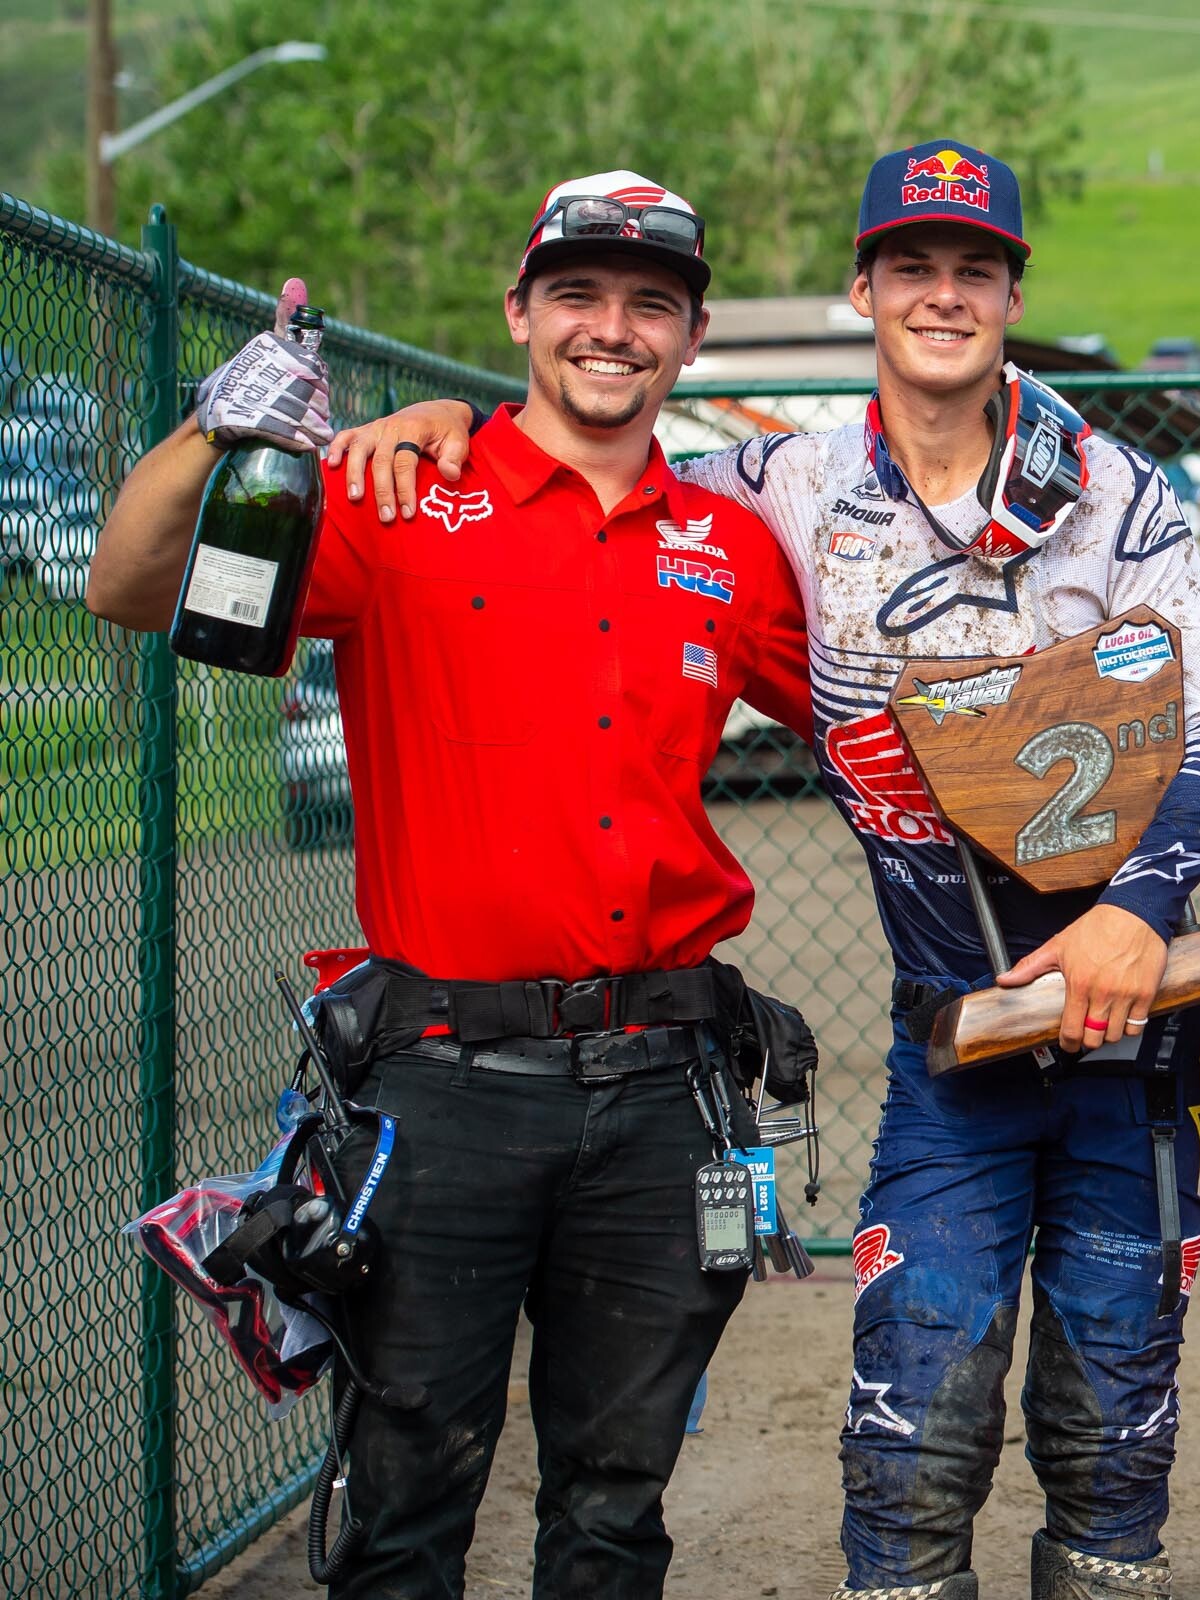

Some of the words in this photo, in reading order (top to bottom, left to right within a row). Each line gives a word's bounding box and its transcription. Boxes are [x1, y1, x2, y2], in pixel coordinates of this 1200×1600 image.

[902, 181, 947, 206] Red
[948, 182, 990, 212] Bull
[1030, 430, 1057, 480] 100%
[831, 498, 897, 527] SHOWA
[657, 540, 729, 560] HONDA
[832, 535, 873, 560] 100%
[656, 555, 735, 604] HRC
[1105, 632, 1136, 649] LUCAS
[1100, 643, 1168, 667] MOTOCROSS
[928, 667, 1021, 700] Thunder
[944, 683, 1012, 712] Valley
[750, 1162, 769, 1174] EW
[347, 1152, 388, 1231] CHRISTIEN
[760, 1185, 769, 1212] 2021
[1138, 1242, 1152, 1250] RACE
